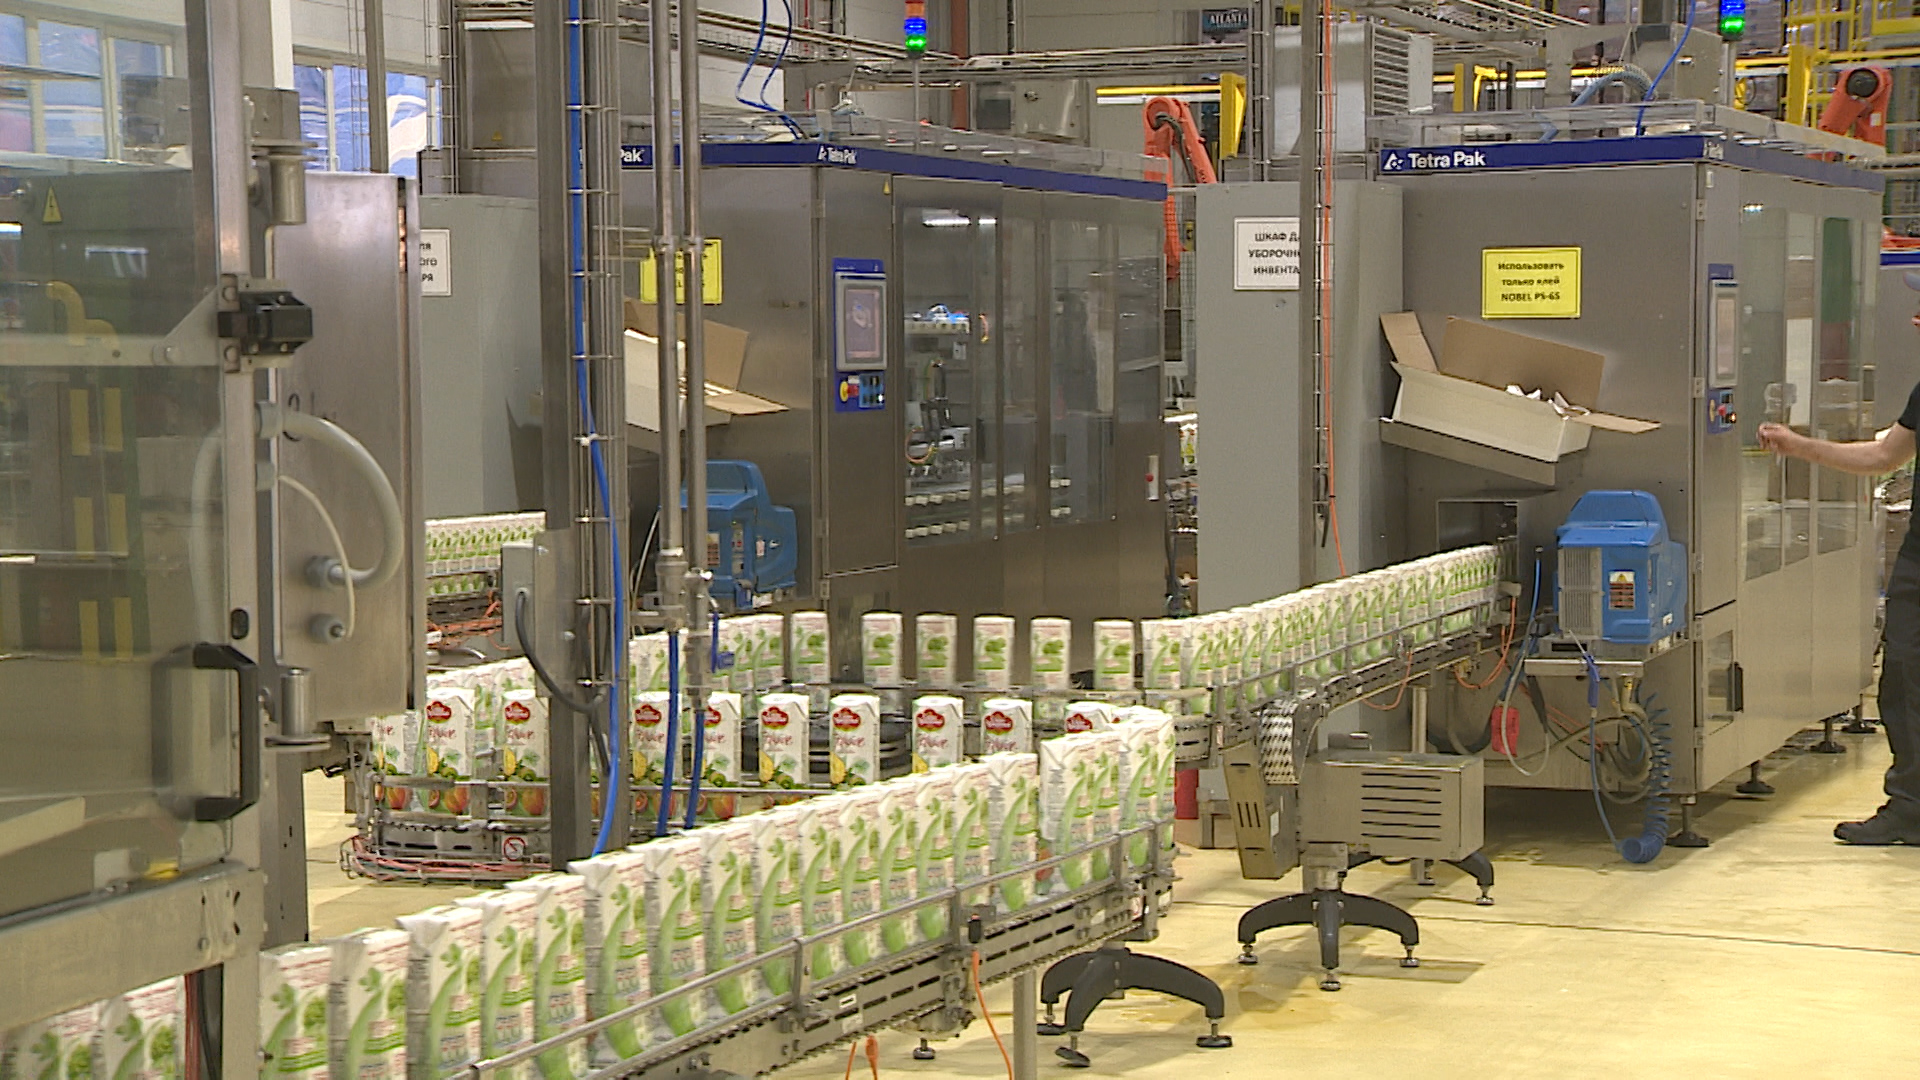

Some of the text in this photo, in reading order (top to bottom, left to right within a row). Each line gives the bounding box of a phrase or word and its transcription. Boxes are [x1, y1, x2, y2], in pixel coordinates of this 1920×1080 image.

[1407, 150, 1486, 169] Tetra Pak
[1254, 232, 1287, 242] ШКАФ
[1248, 249, 1300, 259] УБОРОЧН
[1253, 264, 1300, 275] ИНВЕНТА
[1498, 262, 1564, 270] Использовать
[1502, 276, 1560, 286] только клей
[1501, 293, 1533, 302] NOBEL
